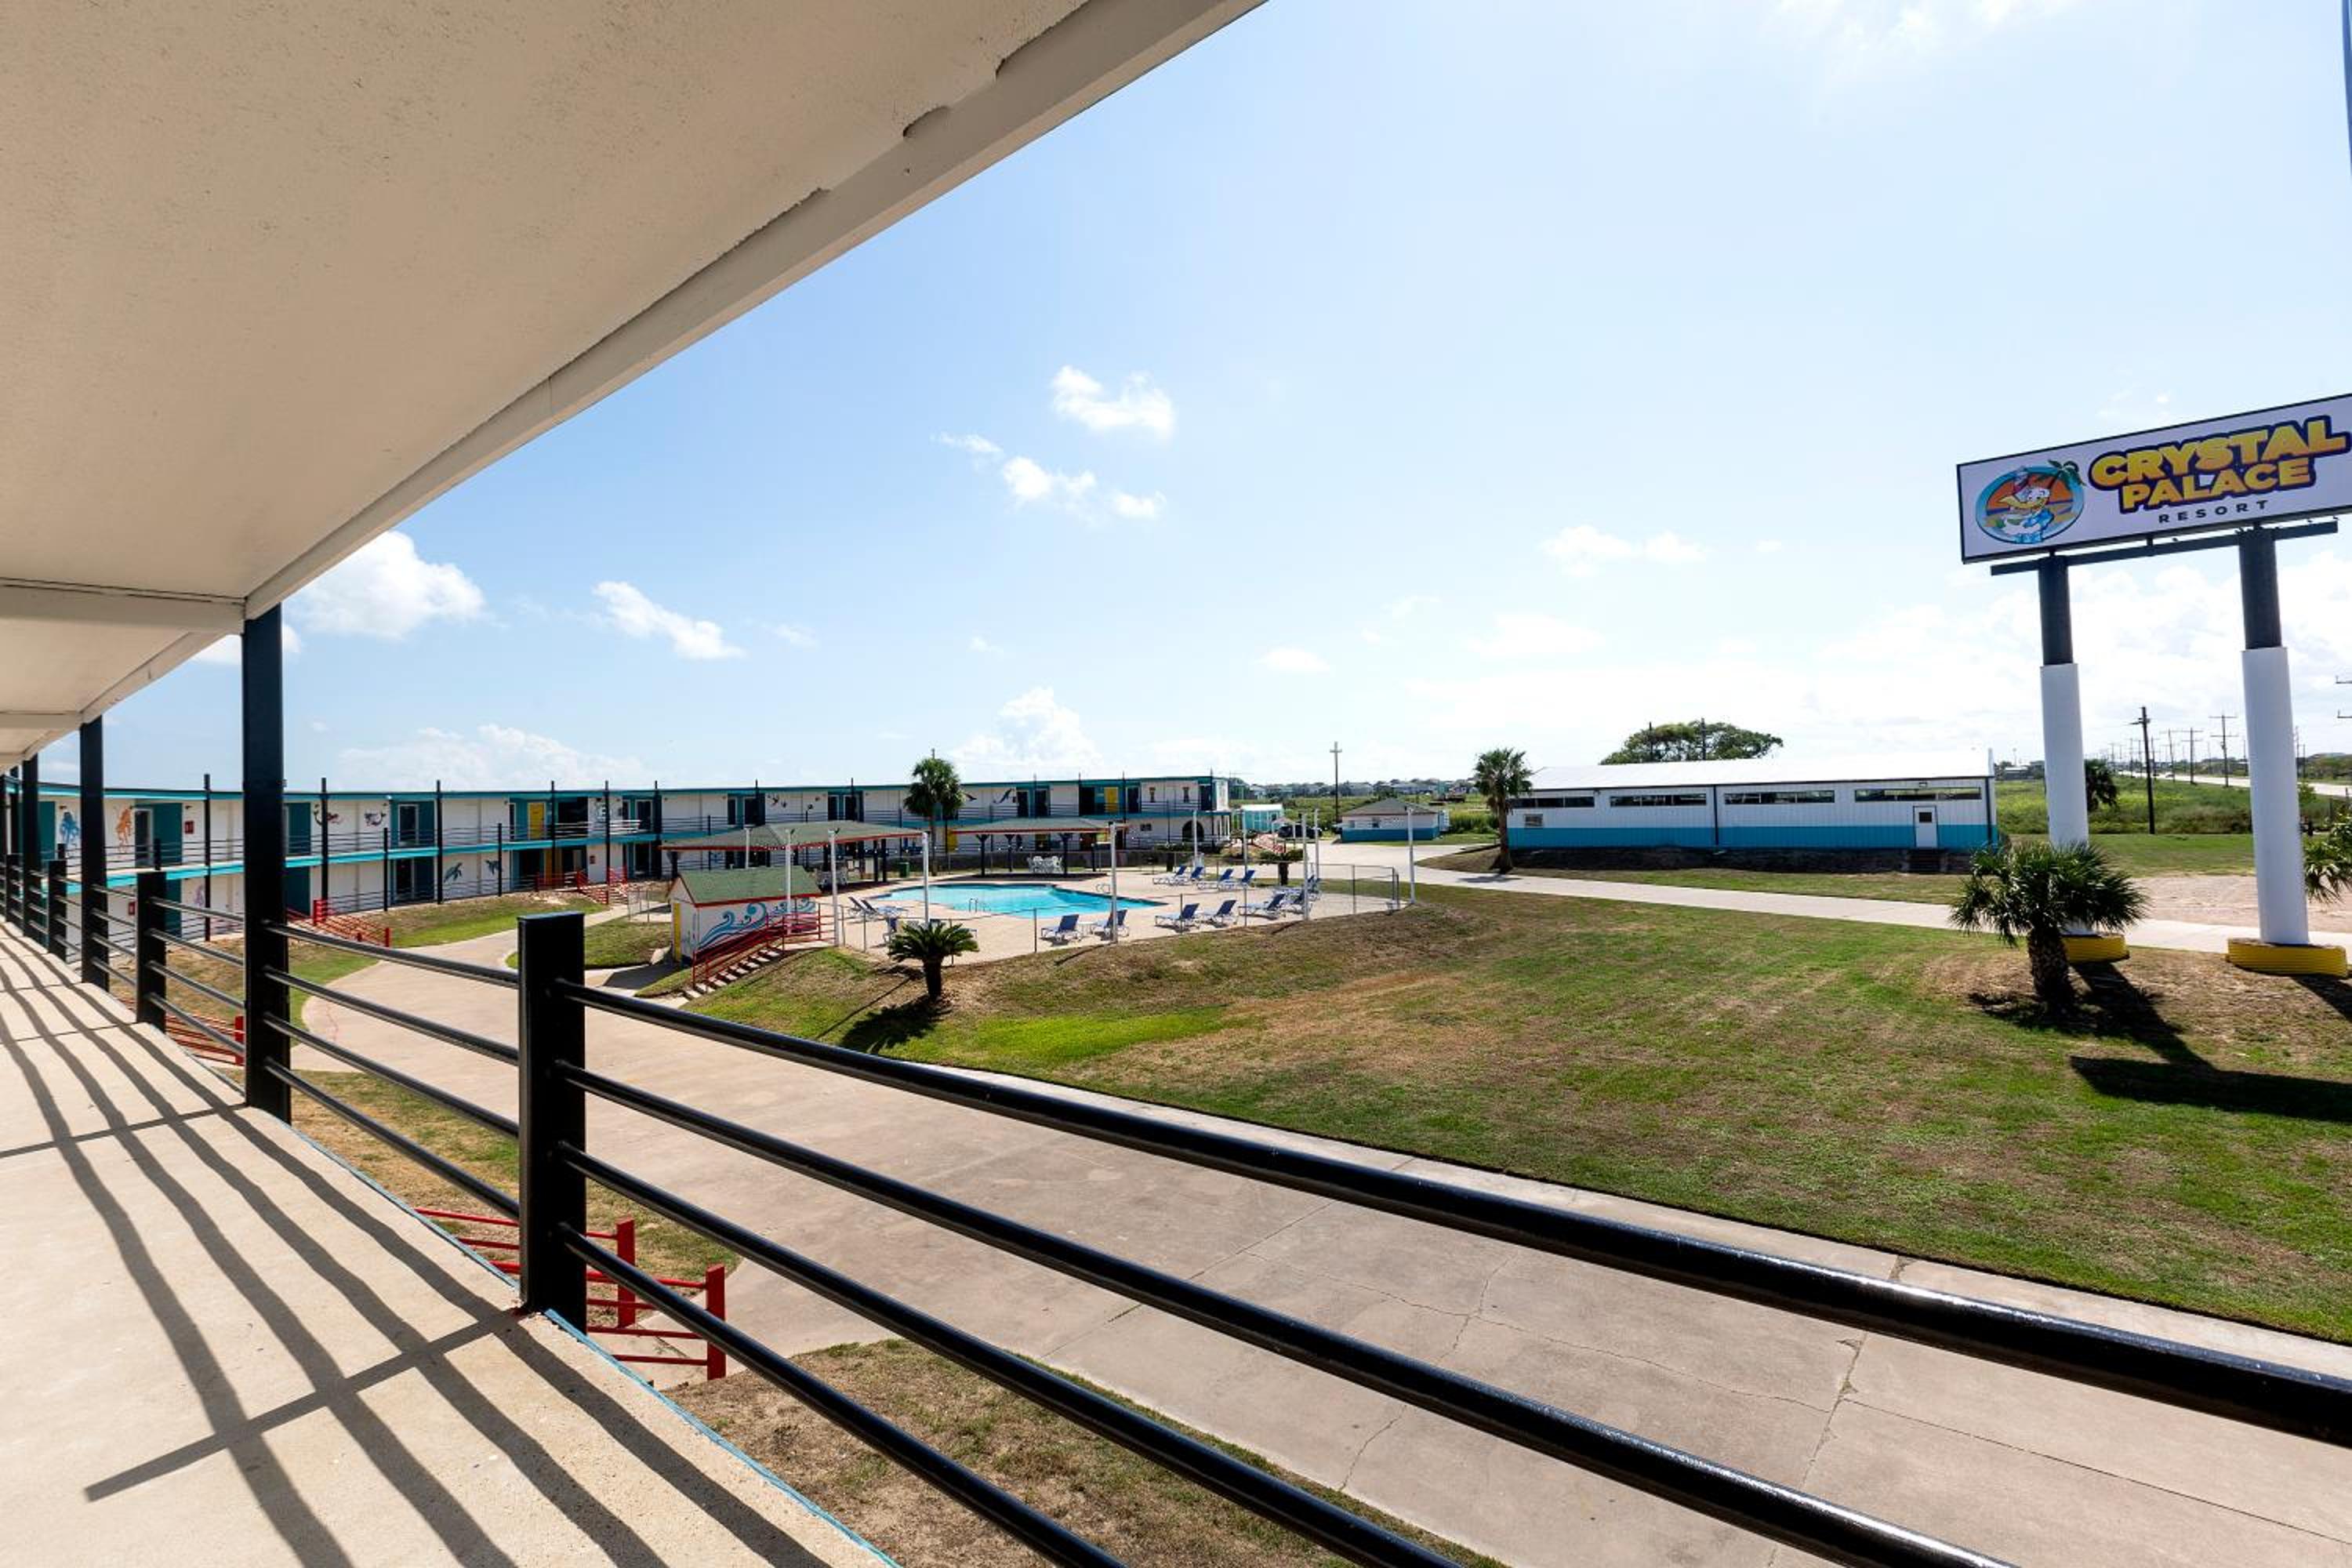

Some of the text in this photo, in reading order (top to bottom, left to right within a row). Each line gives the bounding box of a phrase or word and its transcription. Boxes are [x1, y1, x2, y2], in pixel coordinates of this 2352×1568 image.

[2089, 416, 2350, 489] CRYSTAL
[2120, 458, 2314, 512] PALACE
[2159, 500, 2269, 523] RESORT
